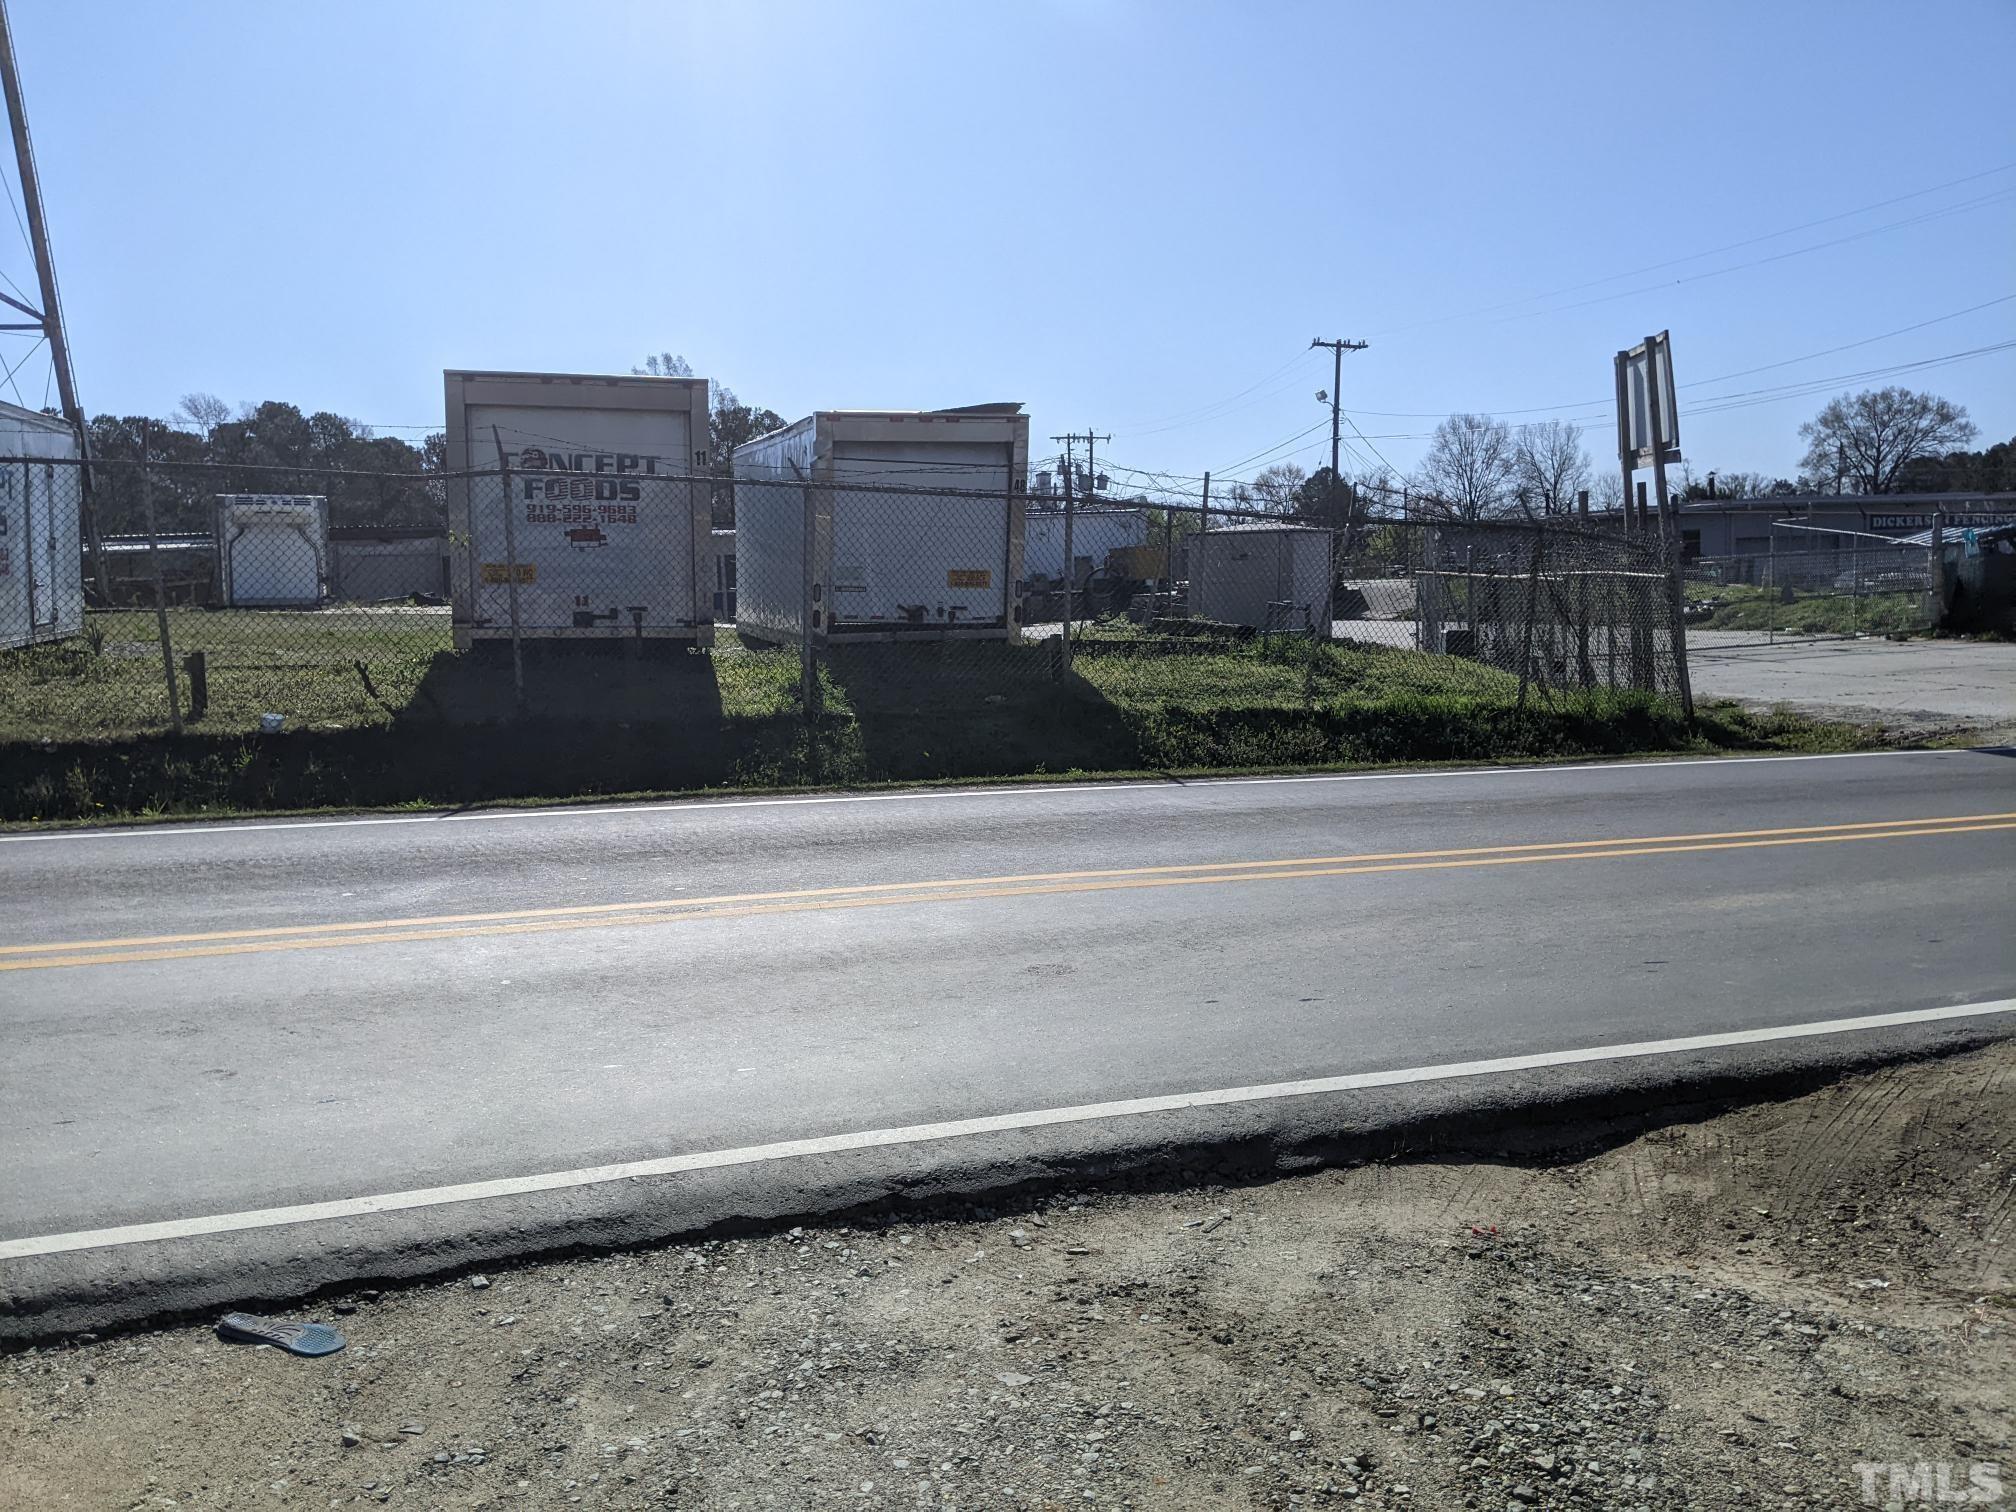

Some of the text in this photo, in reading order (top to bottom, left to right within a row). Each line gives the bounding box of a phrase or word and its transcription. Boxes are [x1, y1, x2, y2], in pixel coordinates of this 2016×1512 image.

[694, 450, 706, 466] 11
[524, 478, 641, 502] FOODS
[1872, 515, 1950, 529] DICKERS
